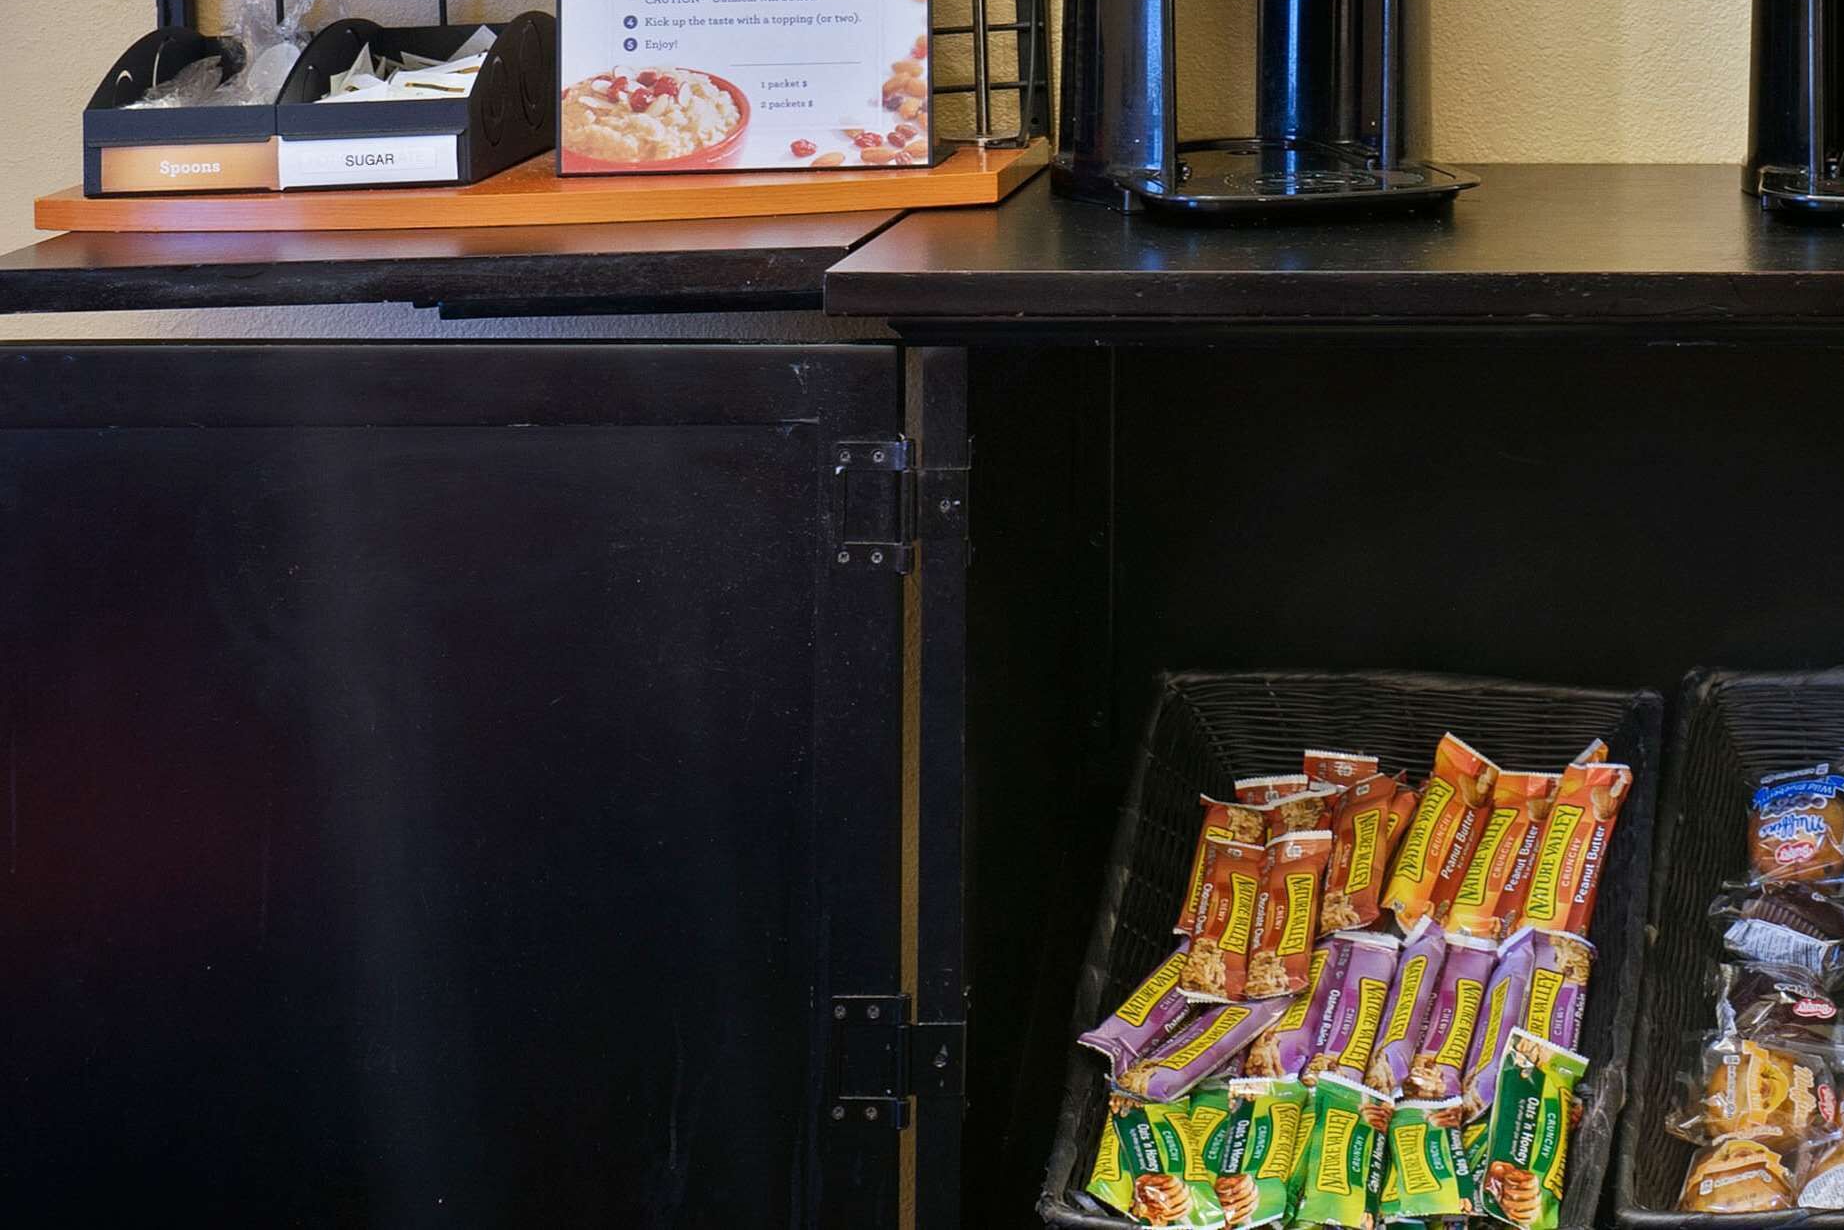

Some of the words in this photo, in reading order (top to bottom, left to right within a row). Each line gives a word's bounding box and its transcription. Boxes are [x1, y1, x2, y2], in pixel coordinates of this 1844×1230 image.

[644, 17, 669, 27] Kick
[672, 19, 686, 28] up
[689, 16, 705, 26] the
[708, 17, 734, 26] taste
[736, 14, 760, 25] with
[772, 15, 813, 26] topping
[816, 13, 831, 25] (or
[835, 13, 862, 25] two).
[644, 39, 678, 50] Enjoy!
[767, 79, 799, 90] packet
[769, 98, 805, 110] packets
[159, 160, 221, 178] Spoons
[345, 153, 395, 167] SUGAR
[1399, 825, 1429, 879] NATURE
[1420, 780, 1451, 826] VALLEY
[1759, 813, 1828, 841] Muffins
[1441, 843, 1462, 879] Peanut
[1456, 809, 1476, 843] Butter
[1531, 857, 1556, 915] NATURE
[1549, 805, 1578, 857] VALLEY
[1574, 861, 1596, 903] Peanut
[1586, 826, 1606, 861] Butter
